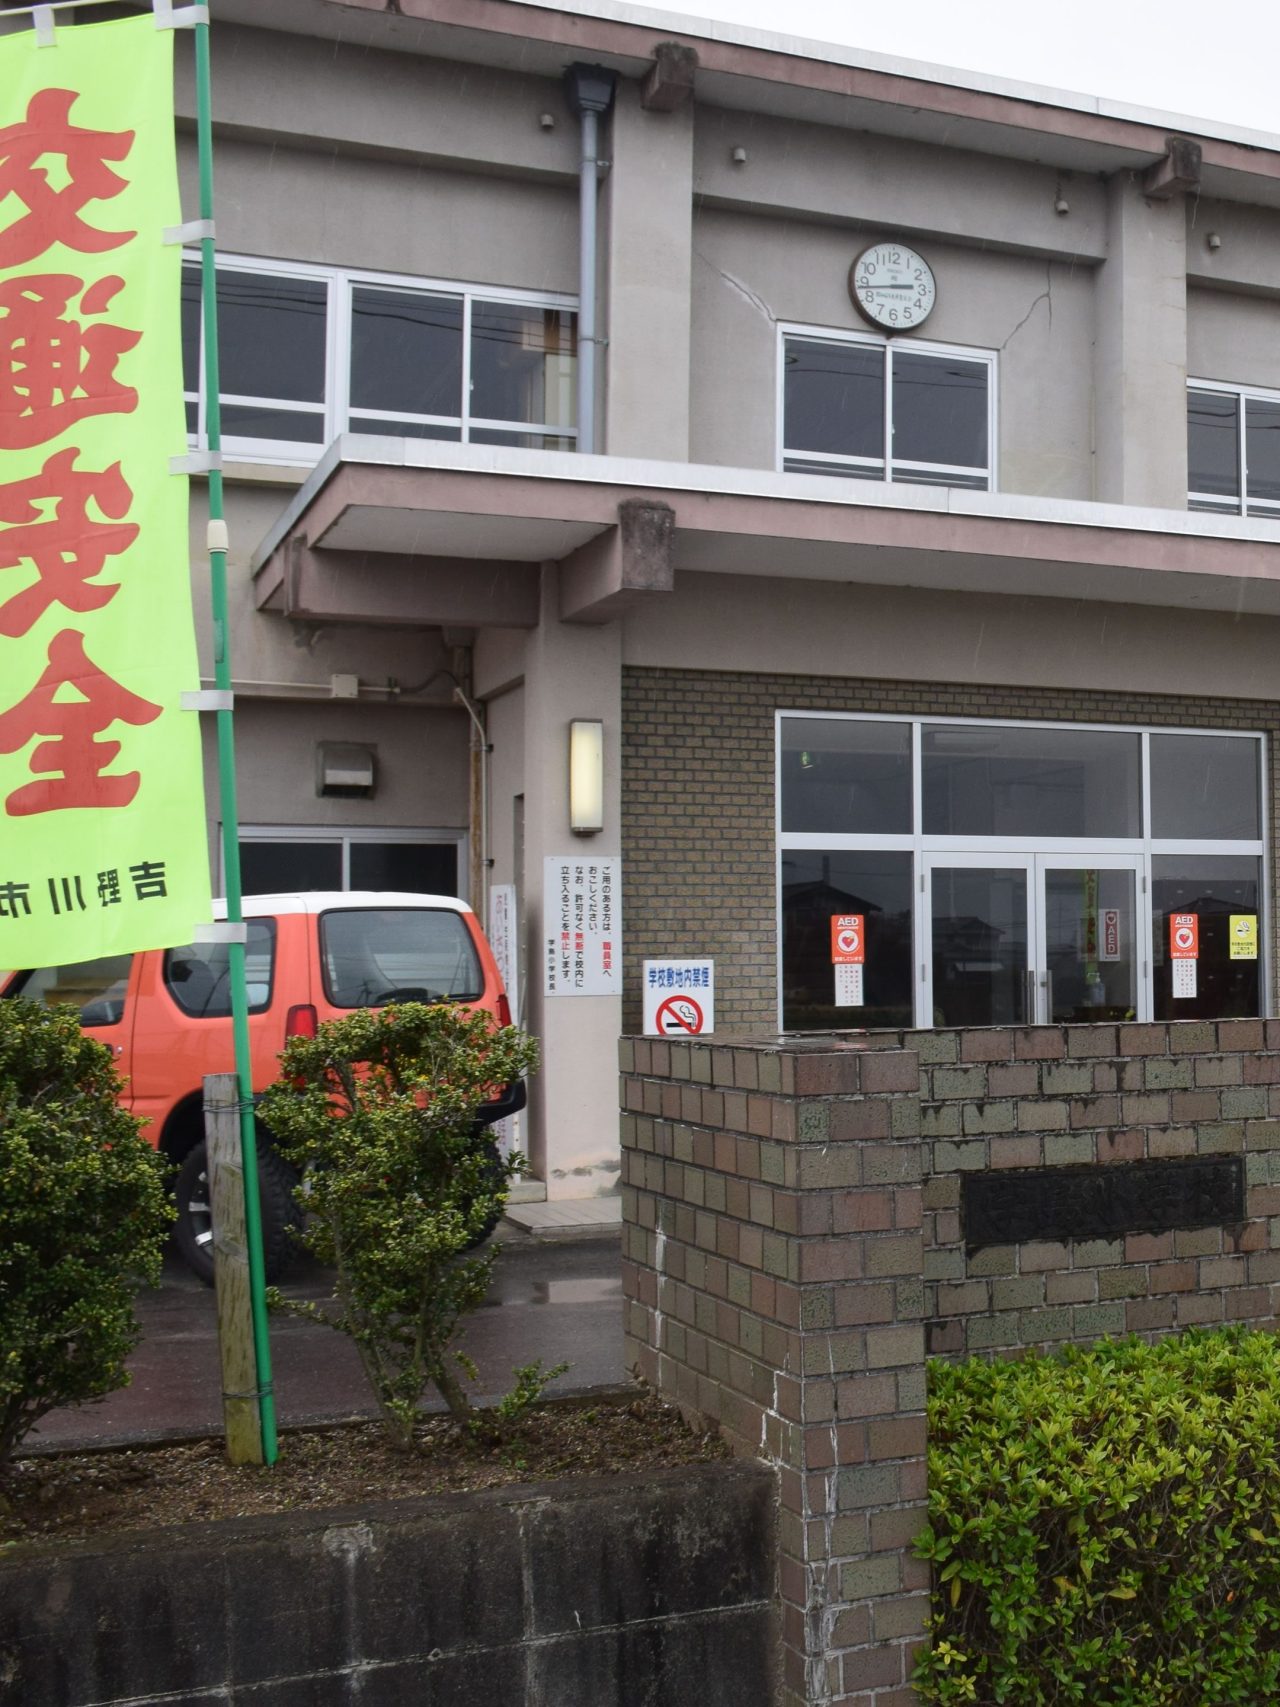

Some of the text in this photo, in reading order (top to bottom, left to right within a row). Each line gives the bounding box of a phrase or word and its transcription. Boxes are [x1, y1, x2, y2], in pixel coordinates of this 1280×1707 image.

[876, 252, 886, 266] 11
[888, 251, 901, 265] 12
[861, 261, 876, 275] 10
[914, 268, 922, 281] 2
[865, 290, 874, 303] 8
[917, 284, 927, 296] 3
[876, 303, 885, 315] 7
[913, 298, 922, 310] 4
[889, 308, 898, 321] 6
[903, 307, 912, 319] 5
[838, 917, 859, 926] AED
[1175, 916, 1194, 924] AED
[648, 967, 710, 988] 学校敷地内禁煙
